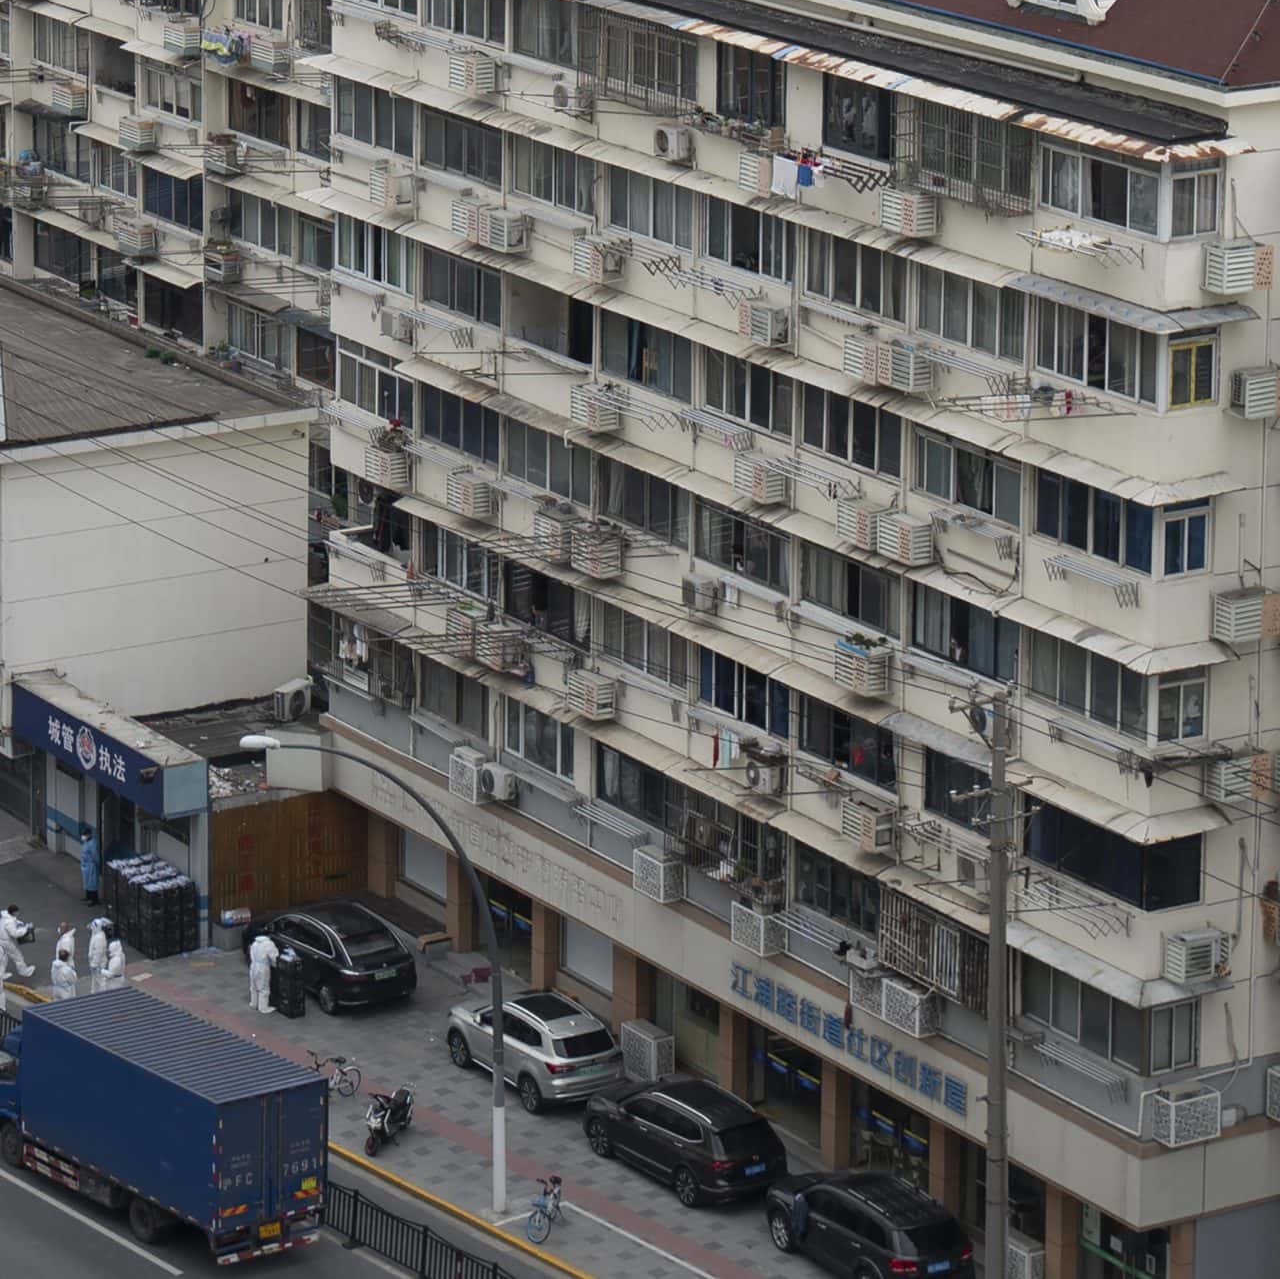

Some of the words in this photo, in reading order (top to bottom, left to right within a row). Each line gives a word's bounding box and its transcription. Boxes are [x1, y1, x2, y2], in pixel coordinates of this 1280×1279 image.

[47, 715, 75, 753] 城管
[98, 744, 127, 783] 执法
[730, 961, 968, 1116] 江浦路街道社区创新屋
